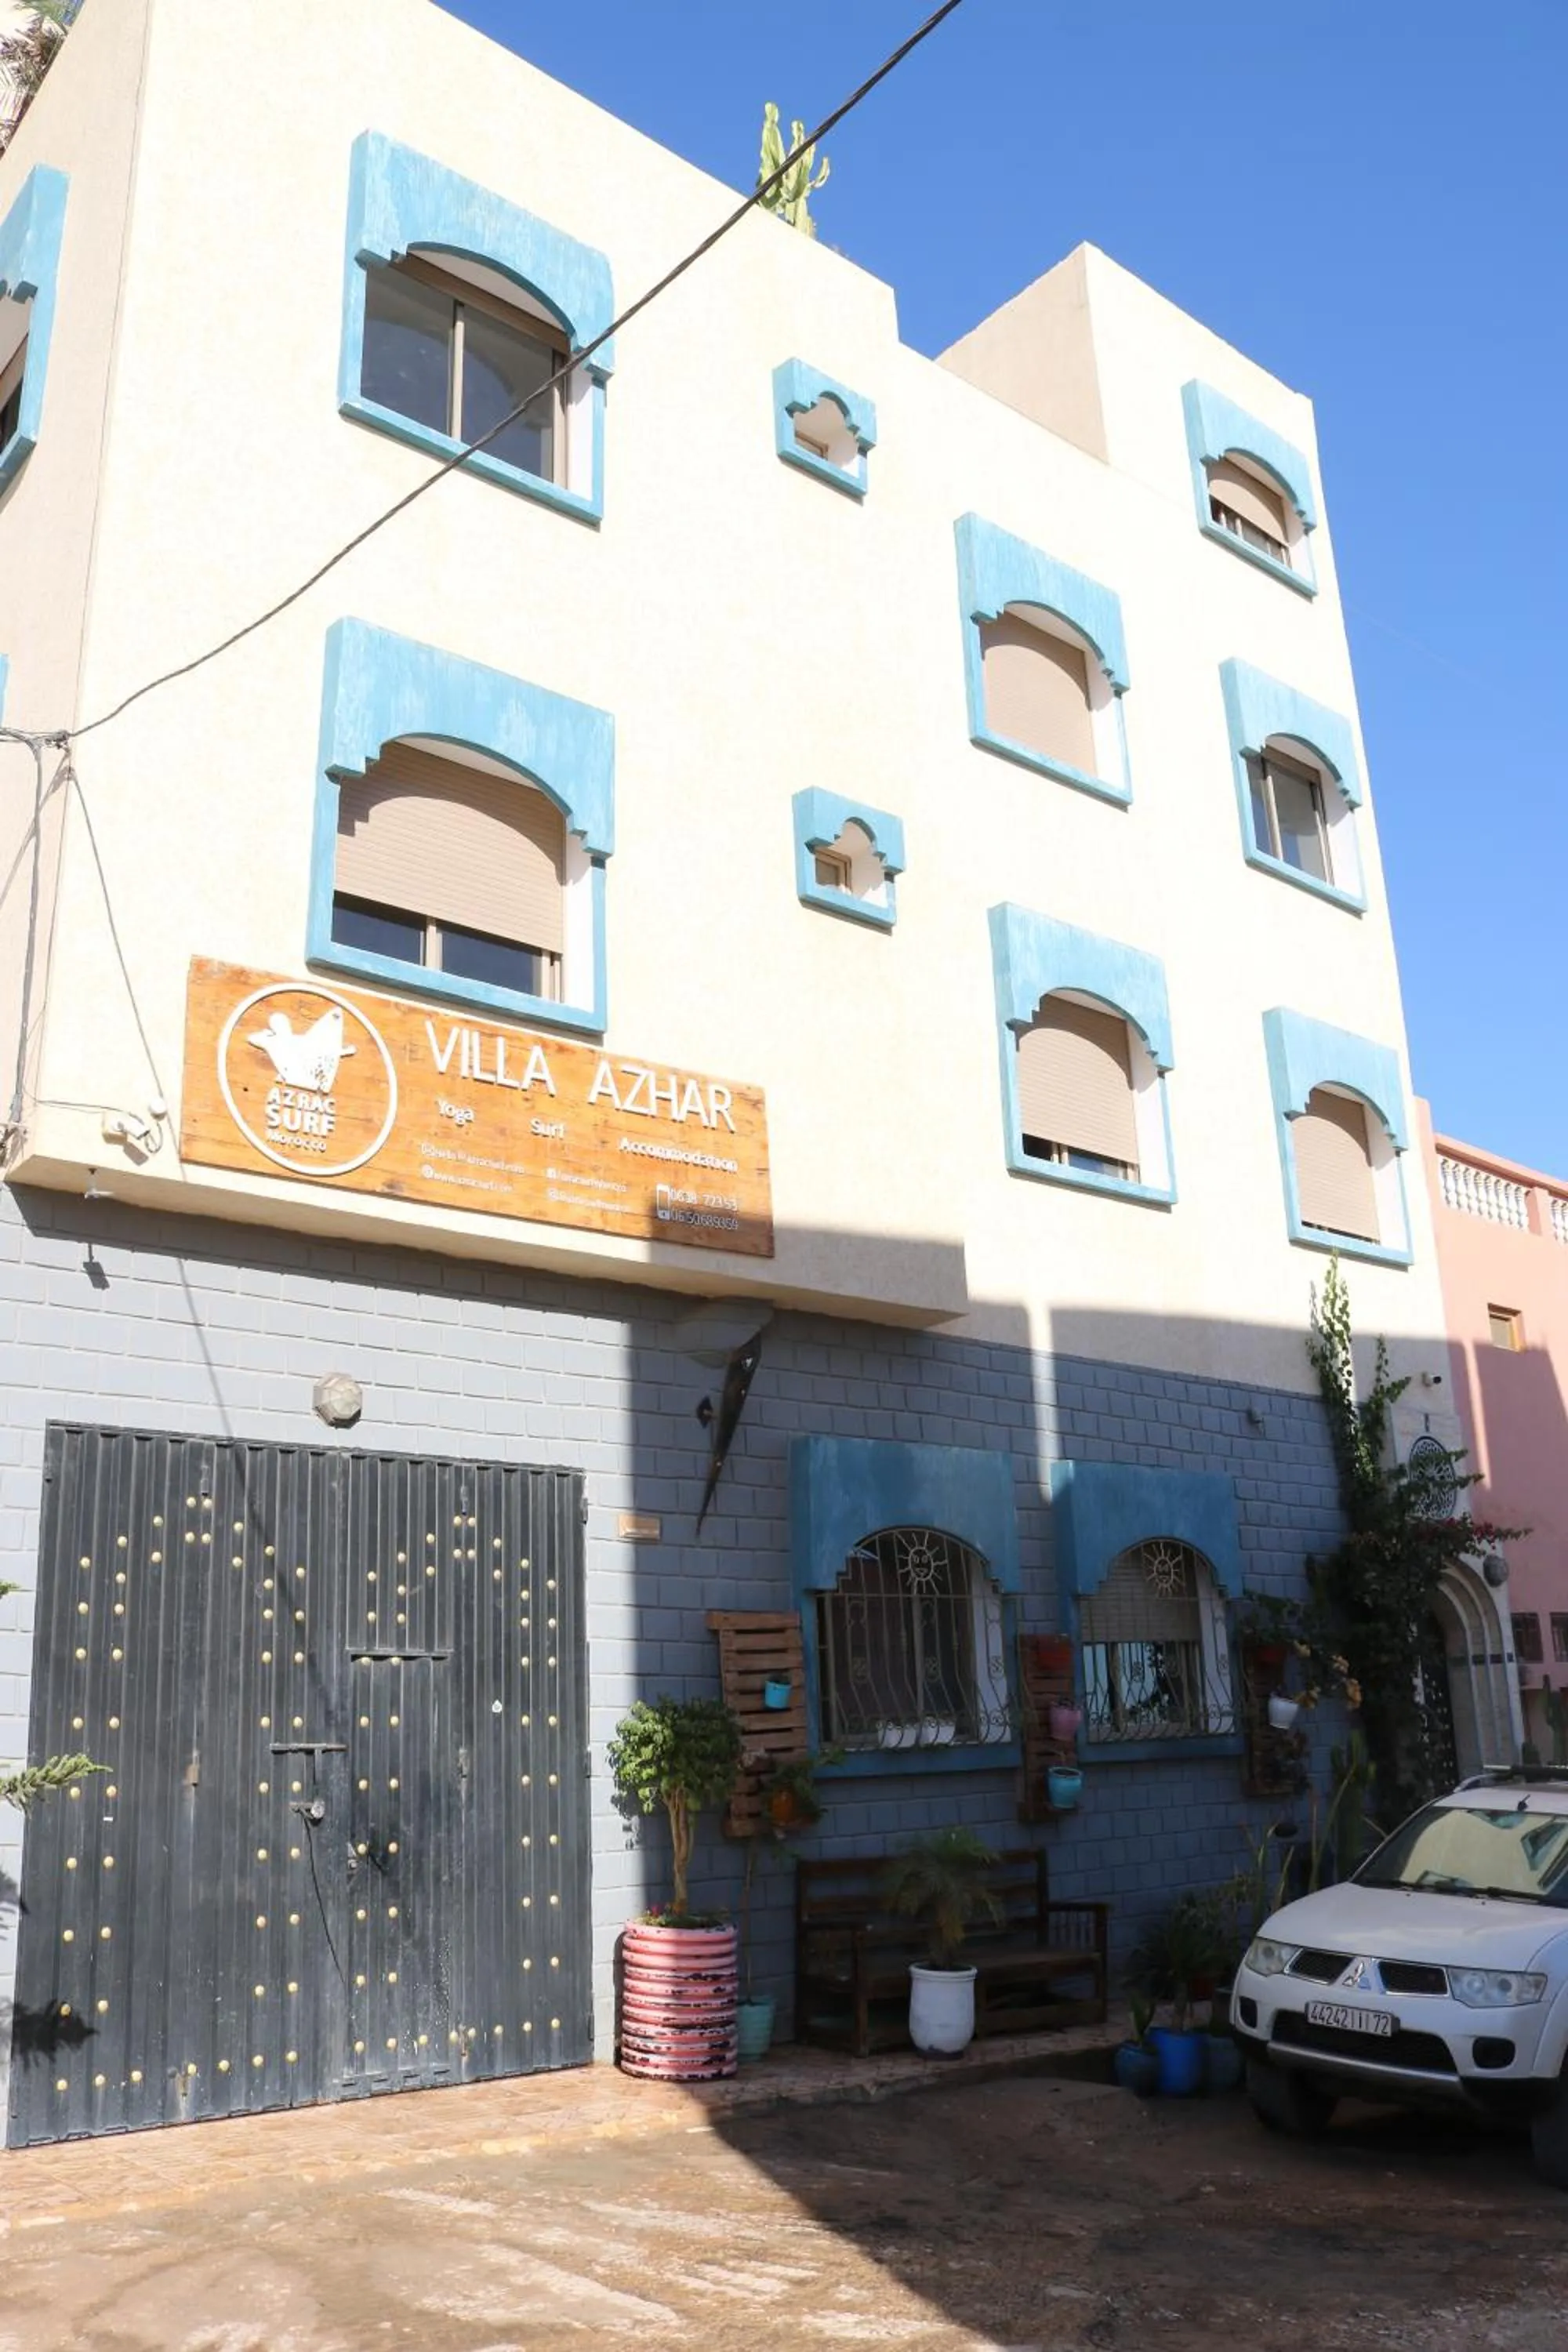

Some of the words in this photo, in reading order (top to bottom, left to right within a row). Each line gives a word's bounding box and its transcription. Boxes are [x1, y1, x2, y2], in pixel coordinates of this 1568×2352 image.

[425, 1020, 557, 1097] VILLA
[587, 1059, 737, 1134] AZHAR
[266, 1086, 336, 1116] AZRAC
[437, 1099, 474, 1126] Yoga
[265, 1104, 336, 1135] SURF
[529, 1117, 565, 1138] Surf
[266, 1129, 328, 1152] Morocco
[618, 1137, 739, 1174] Accommodation
[1310, 2004, 1348, 2029] 44242
[1373, 2013, 1389, 2035] 72
